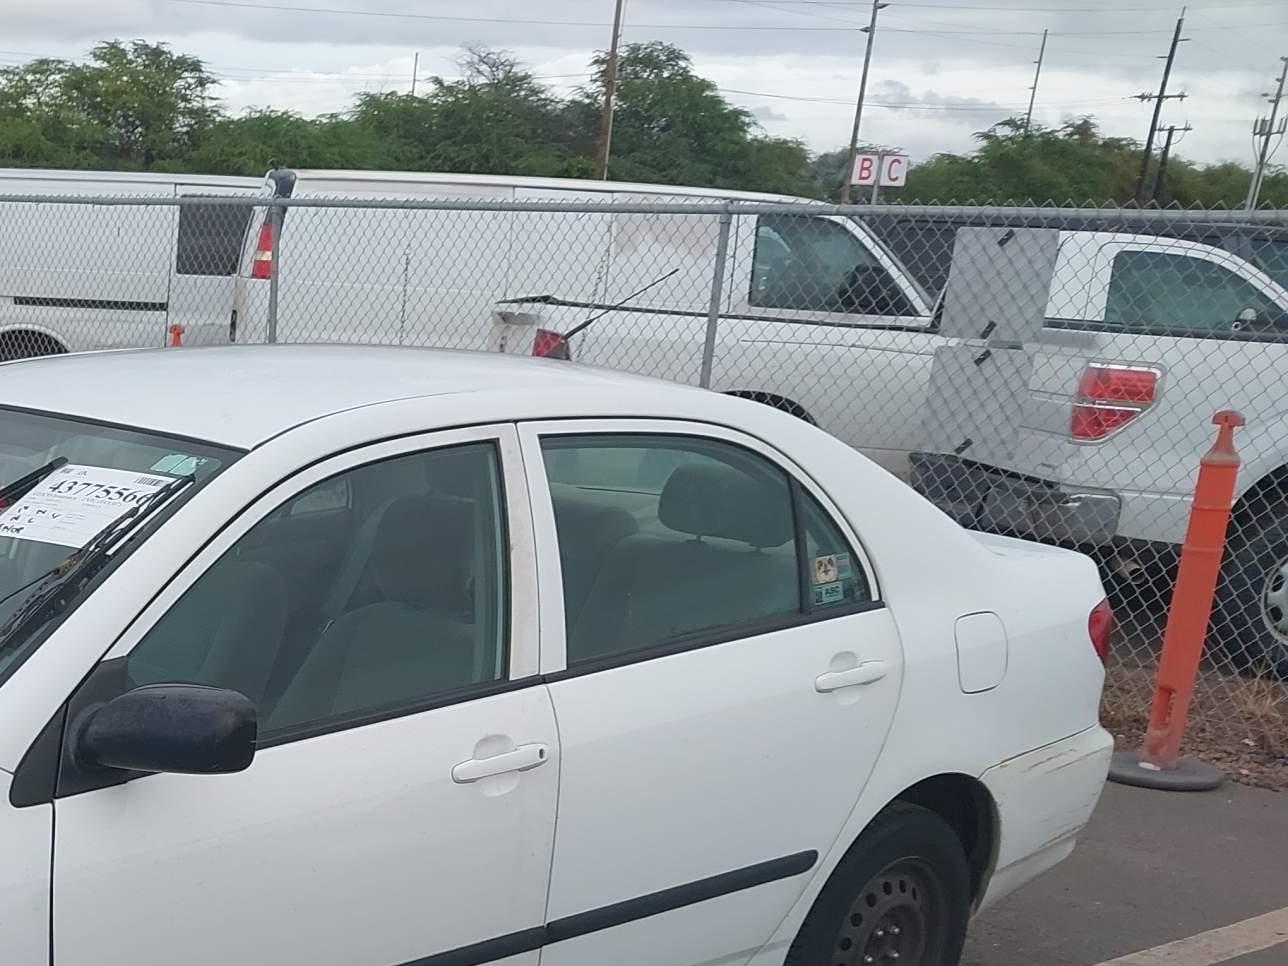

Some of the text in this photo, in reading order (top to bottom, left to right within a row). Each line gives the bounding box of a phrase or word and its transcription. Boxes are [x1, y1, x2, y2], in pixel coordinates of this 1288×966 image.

[858, 157, 873, 181] B
[887, 158, 902, 182] C
[48, 479, 155, 504] 43775566
